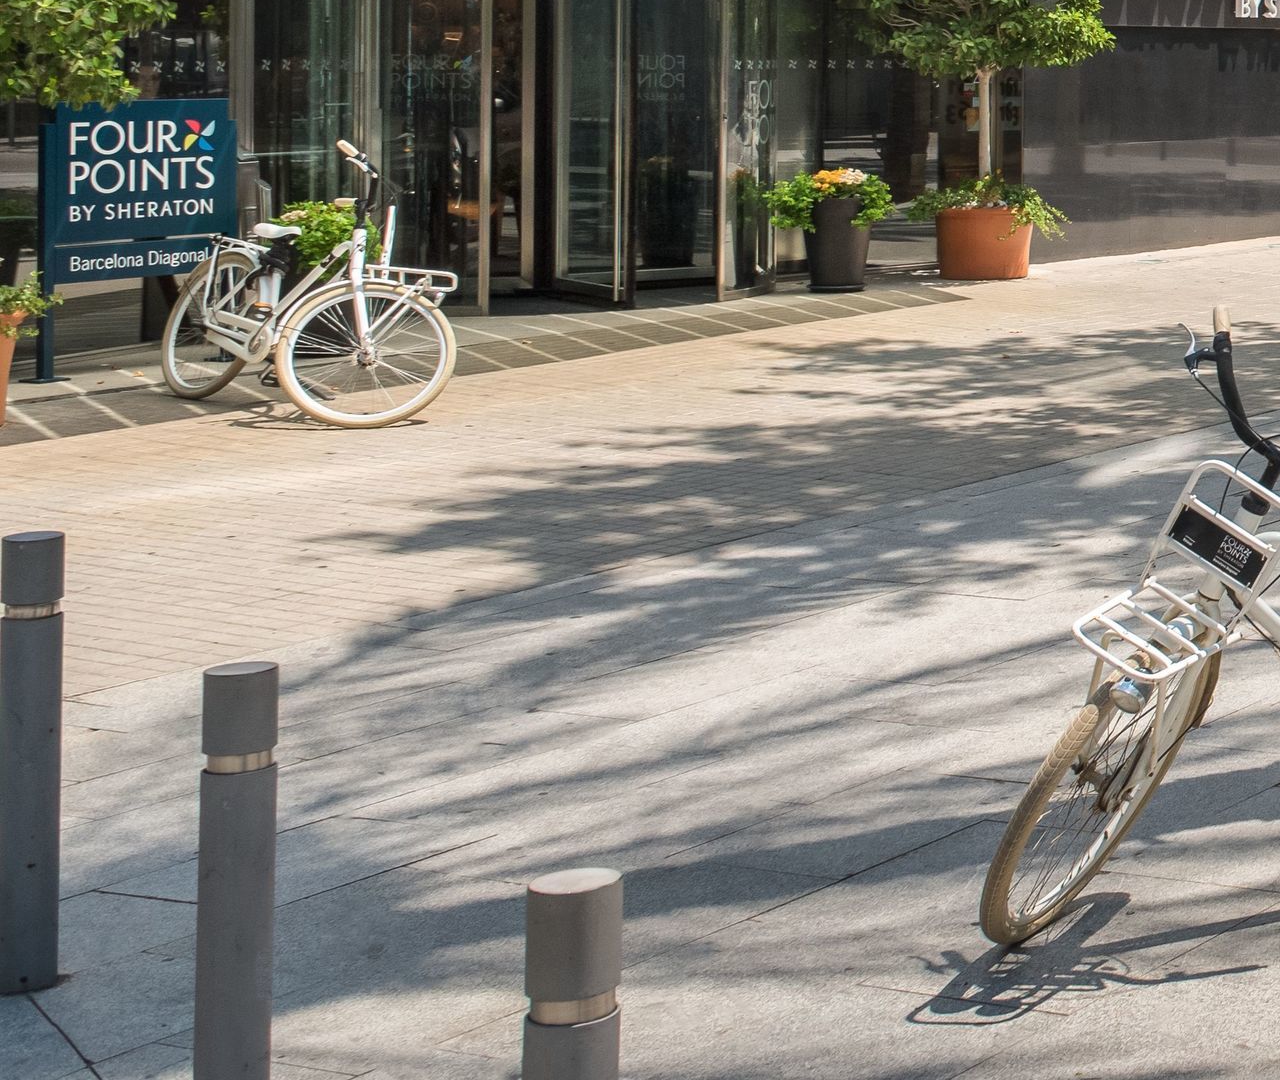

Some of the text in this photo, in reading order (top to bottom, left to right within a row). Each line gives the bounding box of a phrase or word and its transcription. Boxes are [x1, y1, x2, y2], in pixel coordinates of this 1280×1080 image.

[69, 120, 182, 156] FOUR
[69, 155, 215, 195] POINTS
[69, 198, 214, 222] BY SHERATON
[70, 246, 209, 272] Barcelona Diagonal
[1220, 541, 1248, 564] POINTS
[1223, 534, 1246, 552] FOUR
